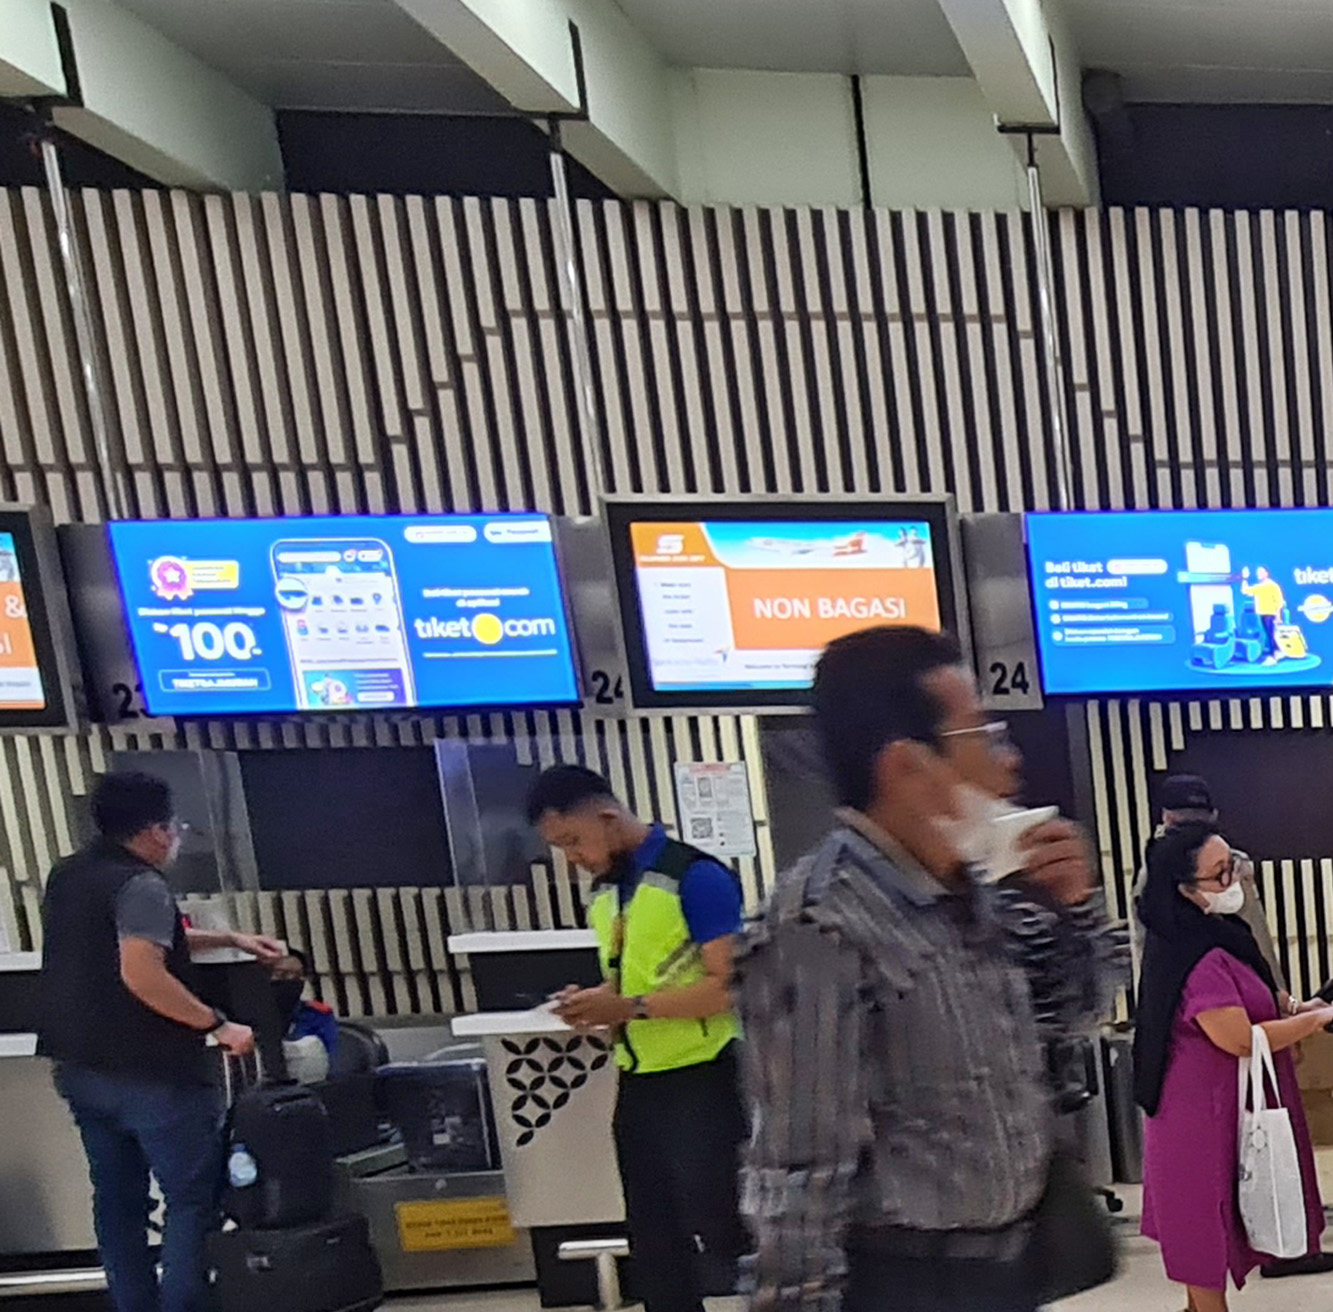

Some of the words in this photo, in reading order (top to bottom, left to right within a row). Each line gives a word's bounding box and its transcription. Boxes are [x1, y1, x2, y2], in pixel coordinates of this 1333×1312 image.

[753, 598, 811, 618] NON
[818, 597, 906, 618] BAGASI
[990, 661, 1030, 695] 24
